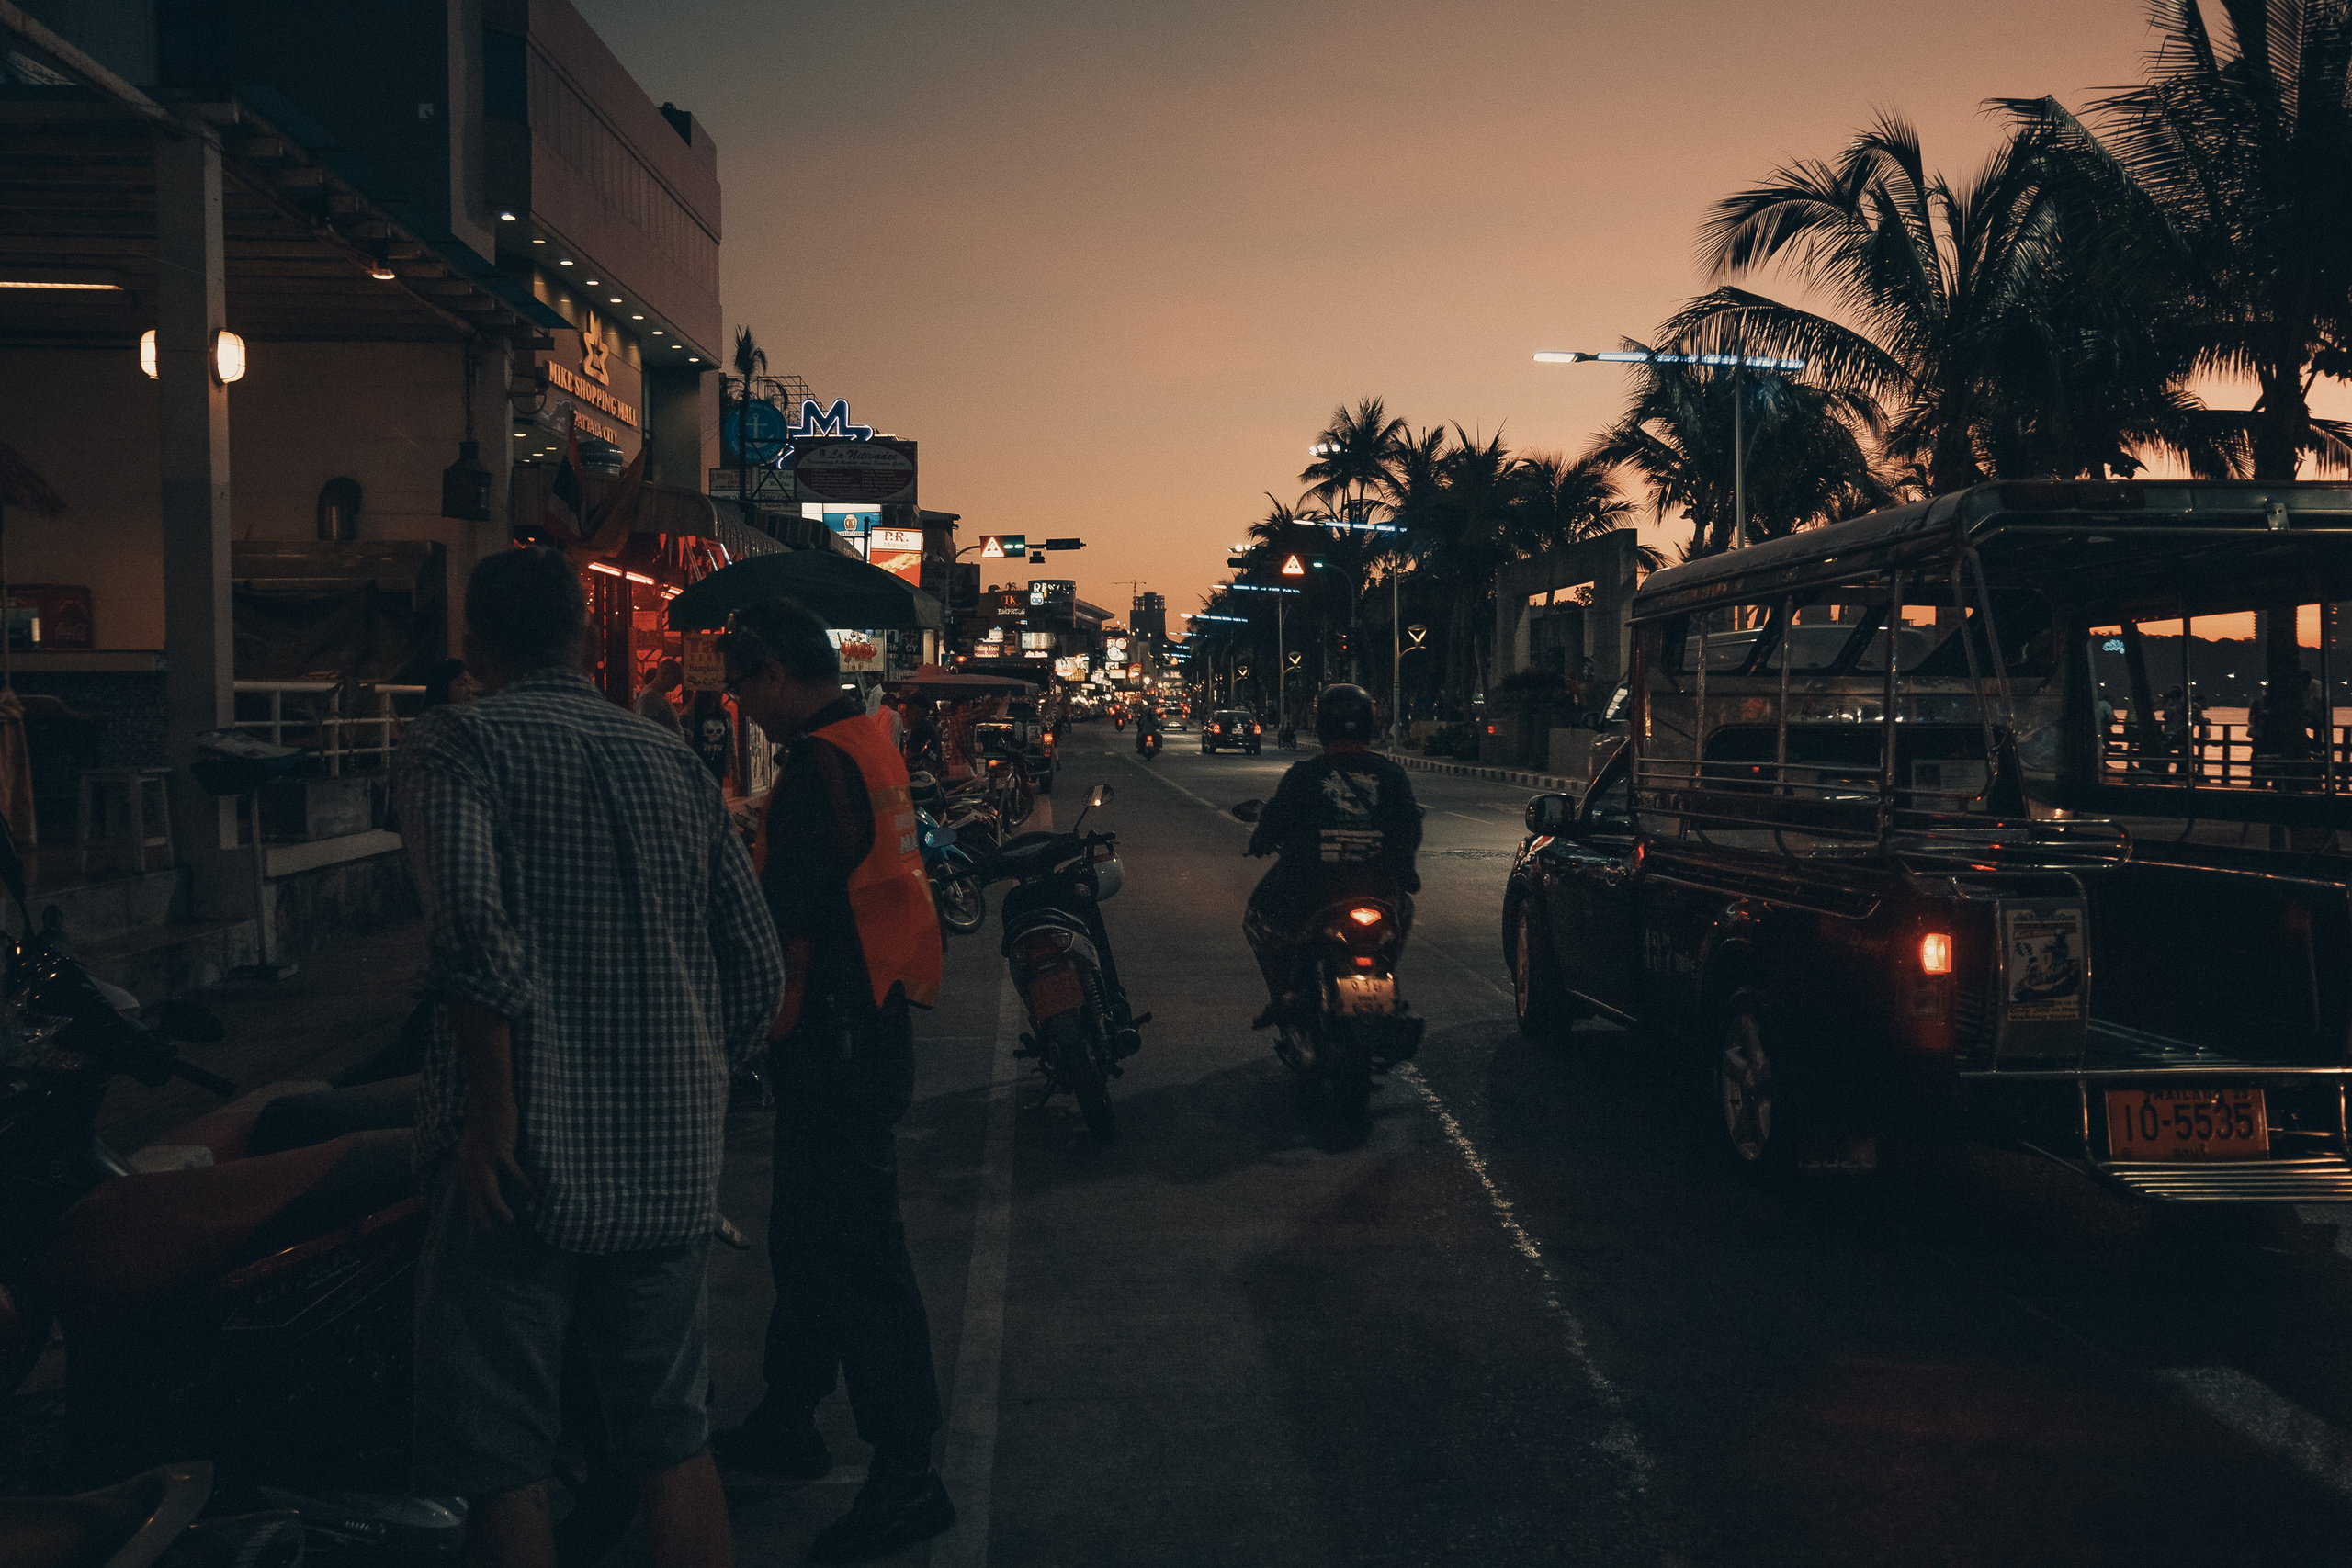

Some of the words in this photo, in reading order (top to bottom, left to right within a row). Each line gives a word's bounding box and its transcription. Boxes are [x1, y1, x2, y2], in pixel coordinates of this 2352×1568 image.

[548, 360, 573, 393] MIKE
[574, 376, 616, 416] SHOPPING
[616, 400, 638, 427] MALL
[573, 409, 603, 439] PATTAYA
[603, 426, 617, 445] CITY
[827, 449, 843, 459] La
[884, 531, 909, 542] P.R.
[2125, 1102, 2254, 1142] 10-5535
